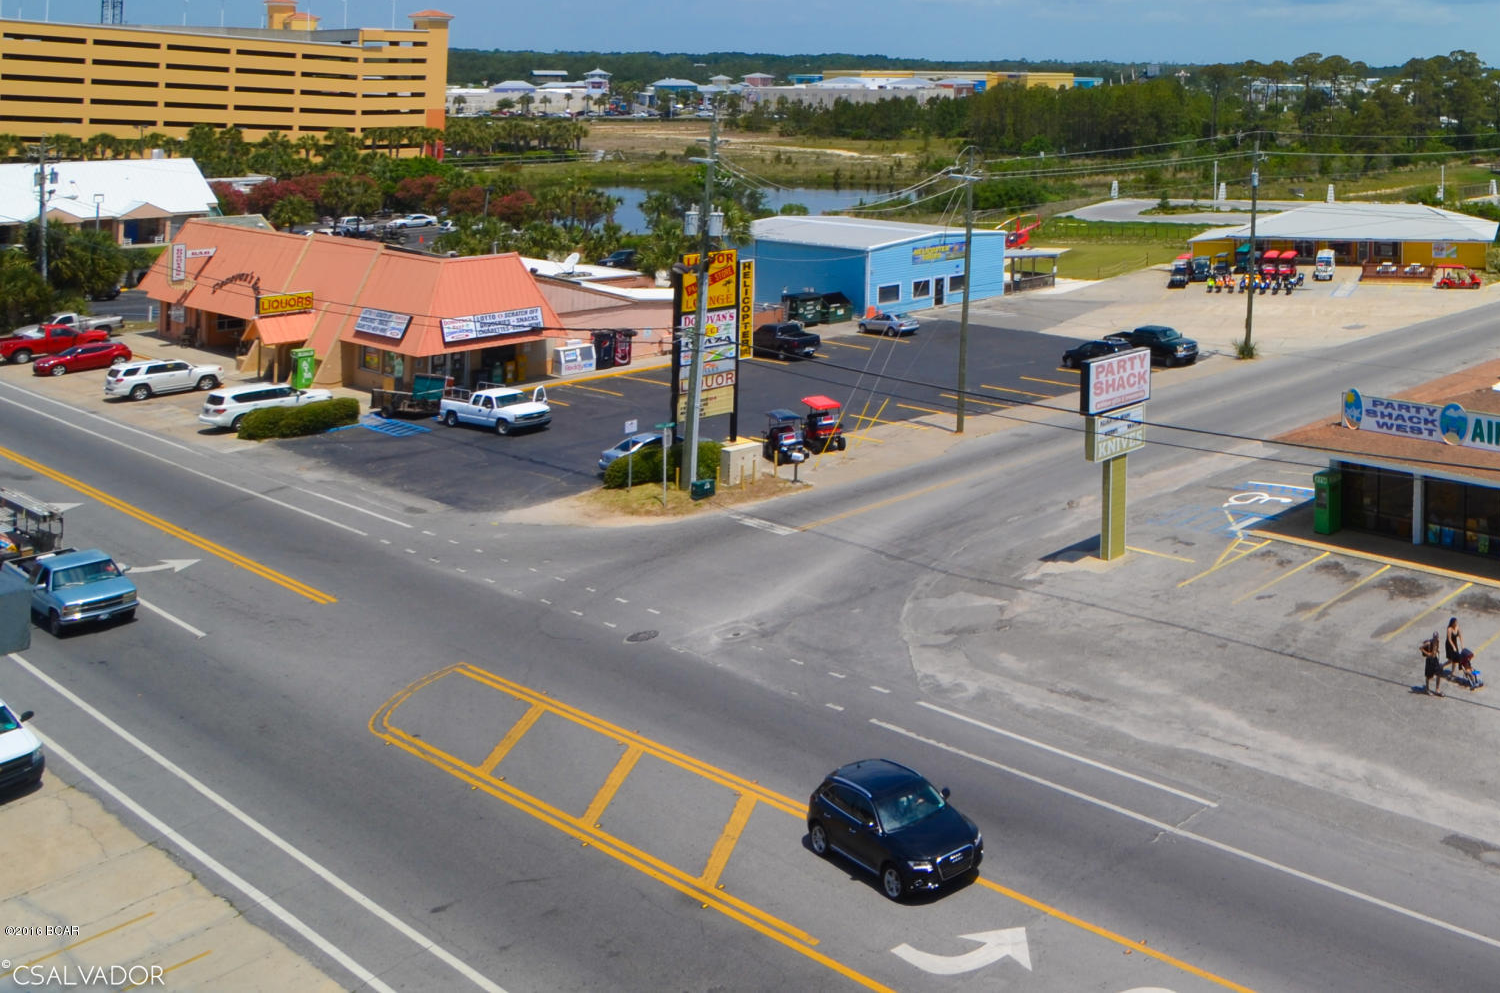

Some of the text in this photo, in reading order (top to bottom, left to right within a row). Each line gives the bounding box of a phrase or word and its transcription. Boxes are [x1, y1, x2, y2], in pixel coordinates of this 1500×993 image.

[686, 253, 734, 266] LIUOR
[261, 295, 313, 311] LIQUORS
[686, 294, 733, 309] LNGE
[742, 262, 751, 346] HELICOPTER
[516, 315, 539, 323] SNACKS
[684, 312, 734, 326] DVAN'S
[1095, 353, 1147, 379] PARTY
[681, 372, 734, 392] LUOR
[1093, 369, 1148, 396] SHACK
[1365, 408, 1438, 427] SHACK
[1371, 399, 1438, 418] PARTY
[1375, 420, 1437, 437] WEST
[1098, 429, 1143, 458] KNIVES
